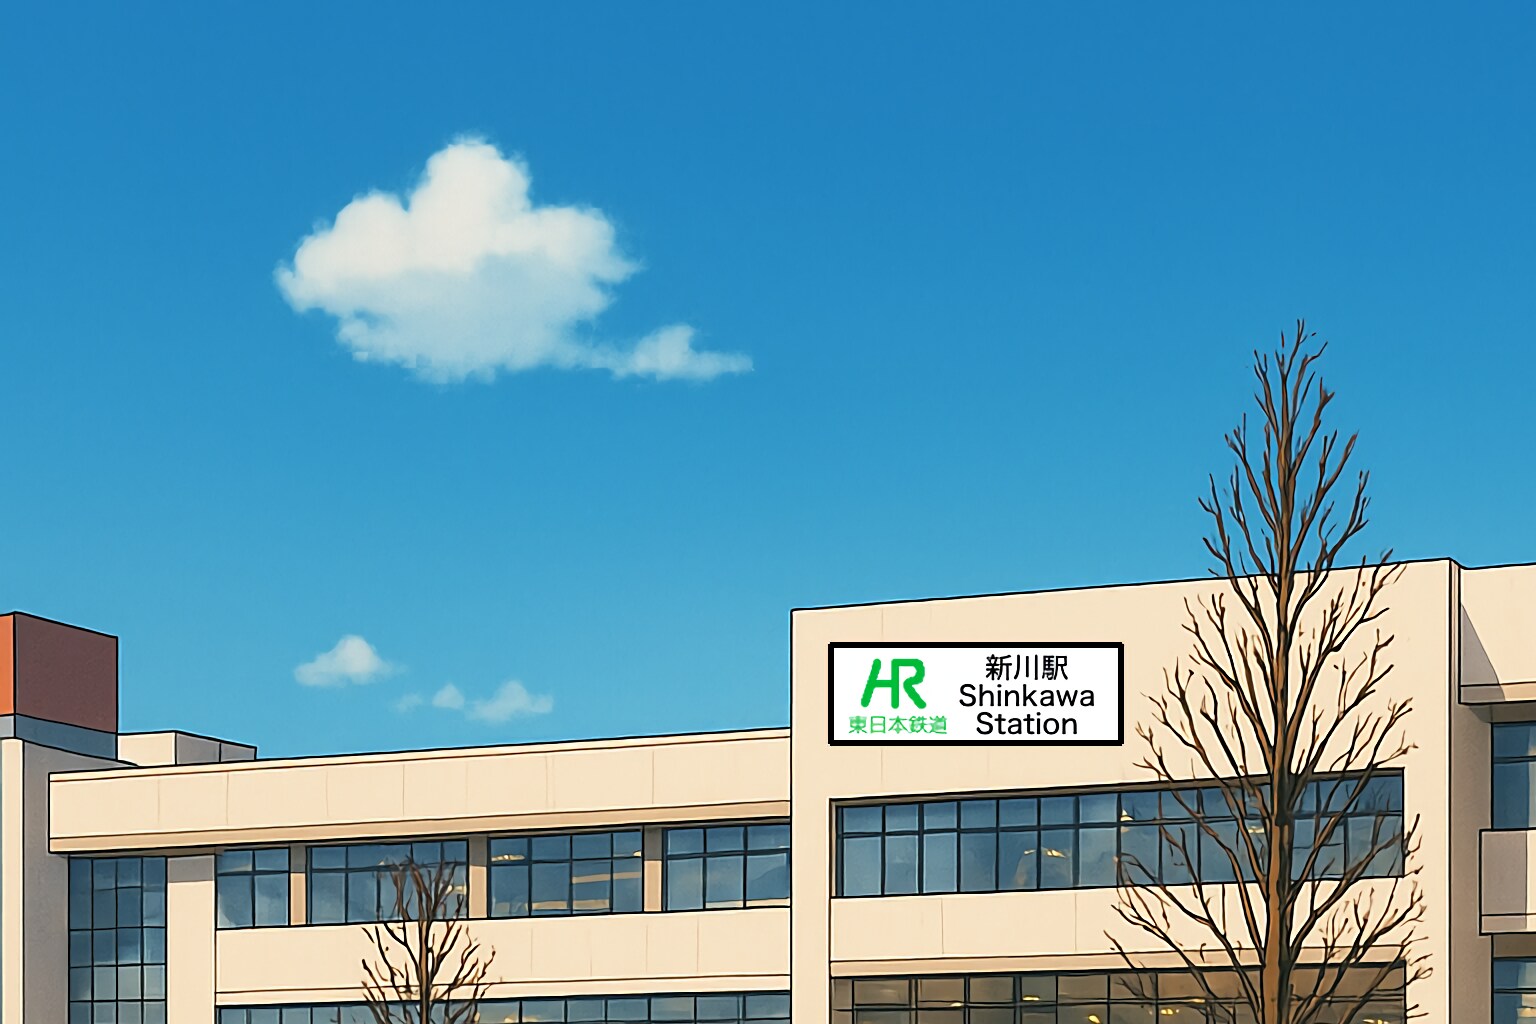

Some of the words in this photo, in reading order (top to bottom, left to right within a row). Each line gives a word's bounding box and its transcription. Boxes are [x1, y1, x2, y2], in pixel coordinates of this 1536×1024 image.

[986, 654, 1068, 681] 新川駅
[960, 684, 1094, 707] Shinkawa
[850, 716, 946, 734] 東日本鉄道
[977, 712, 1077, 735] Station
